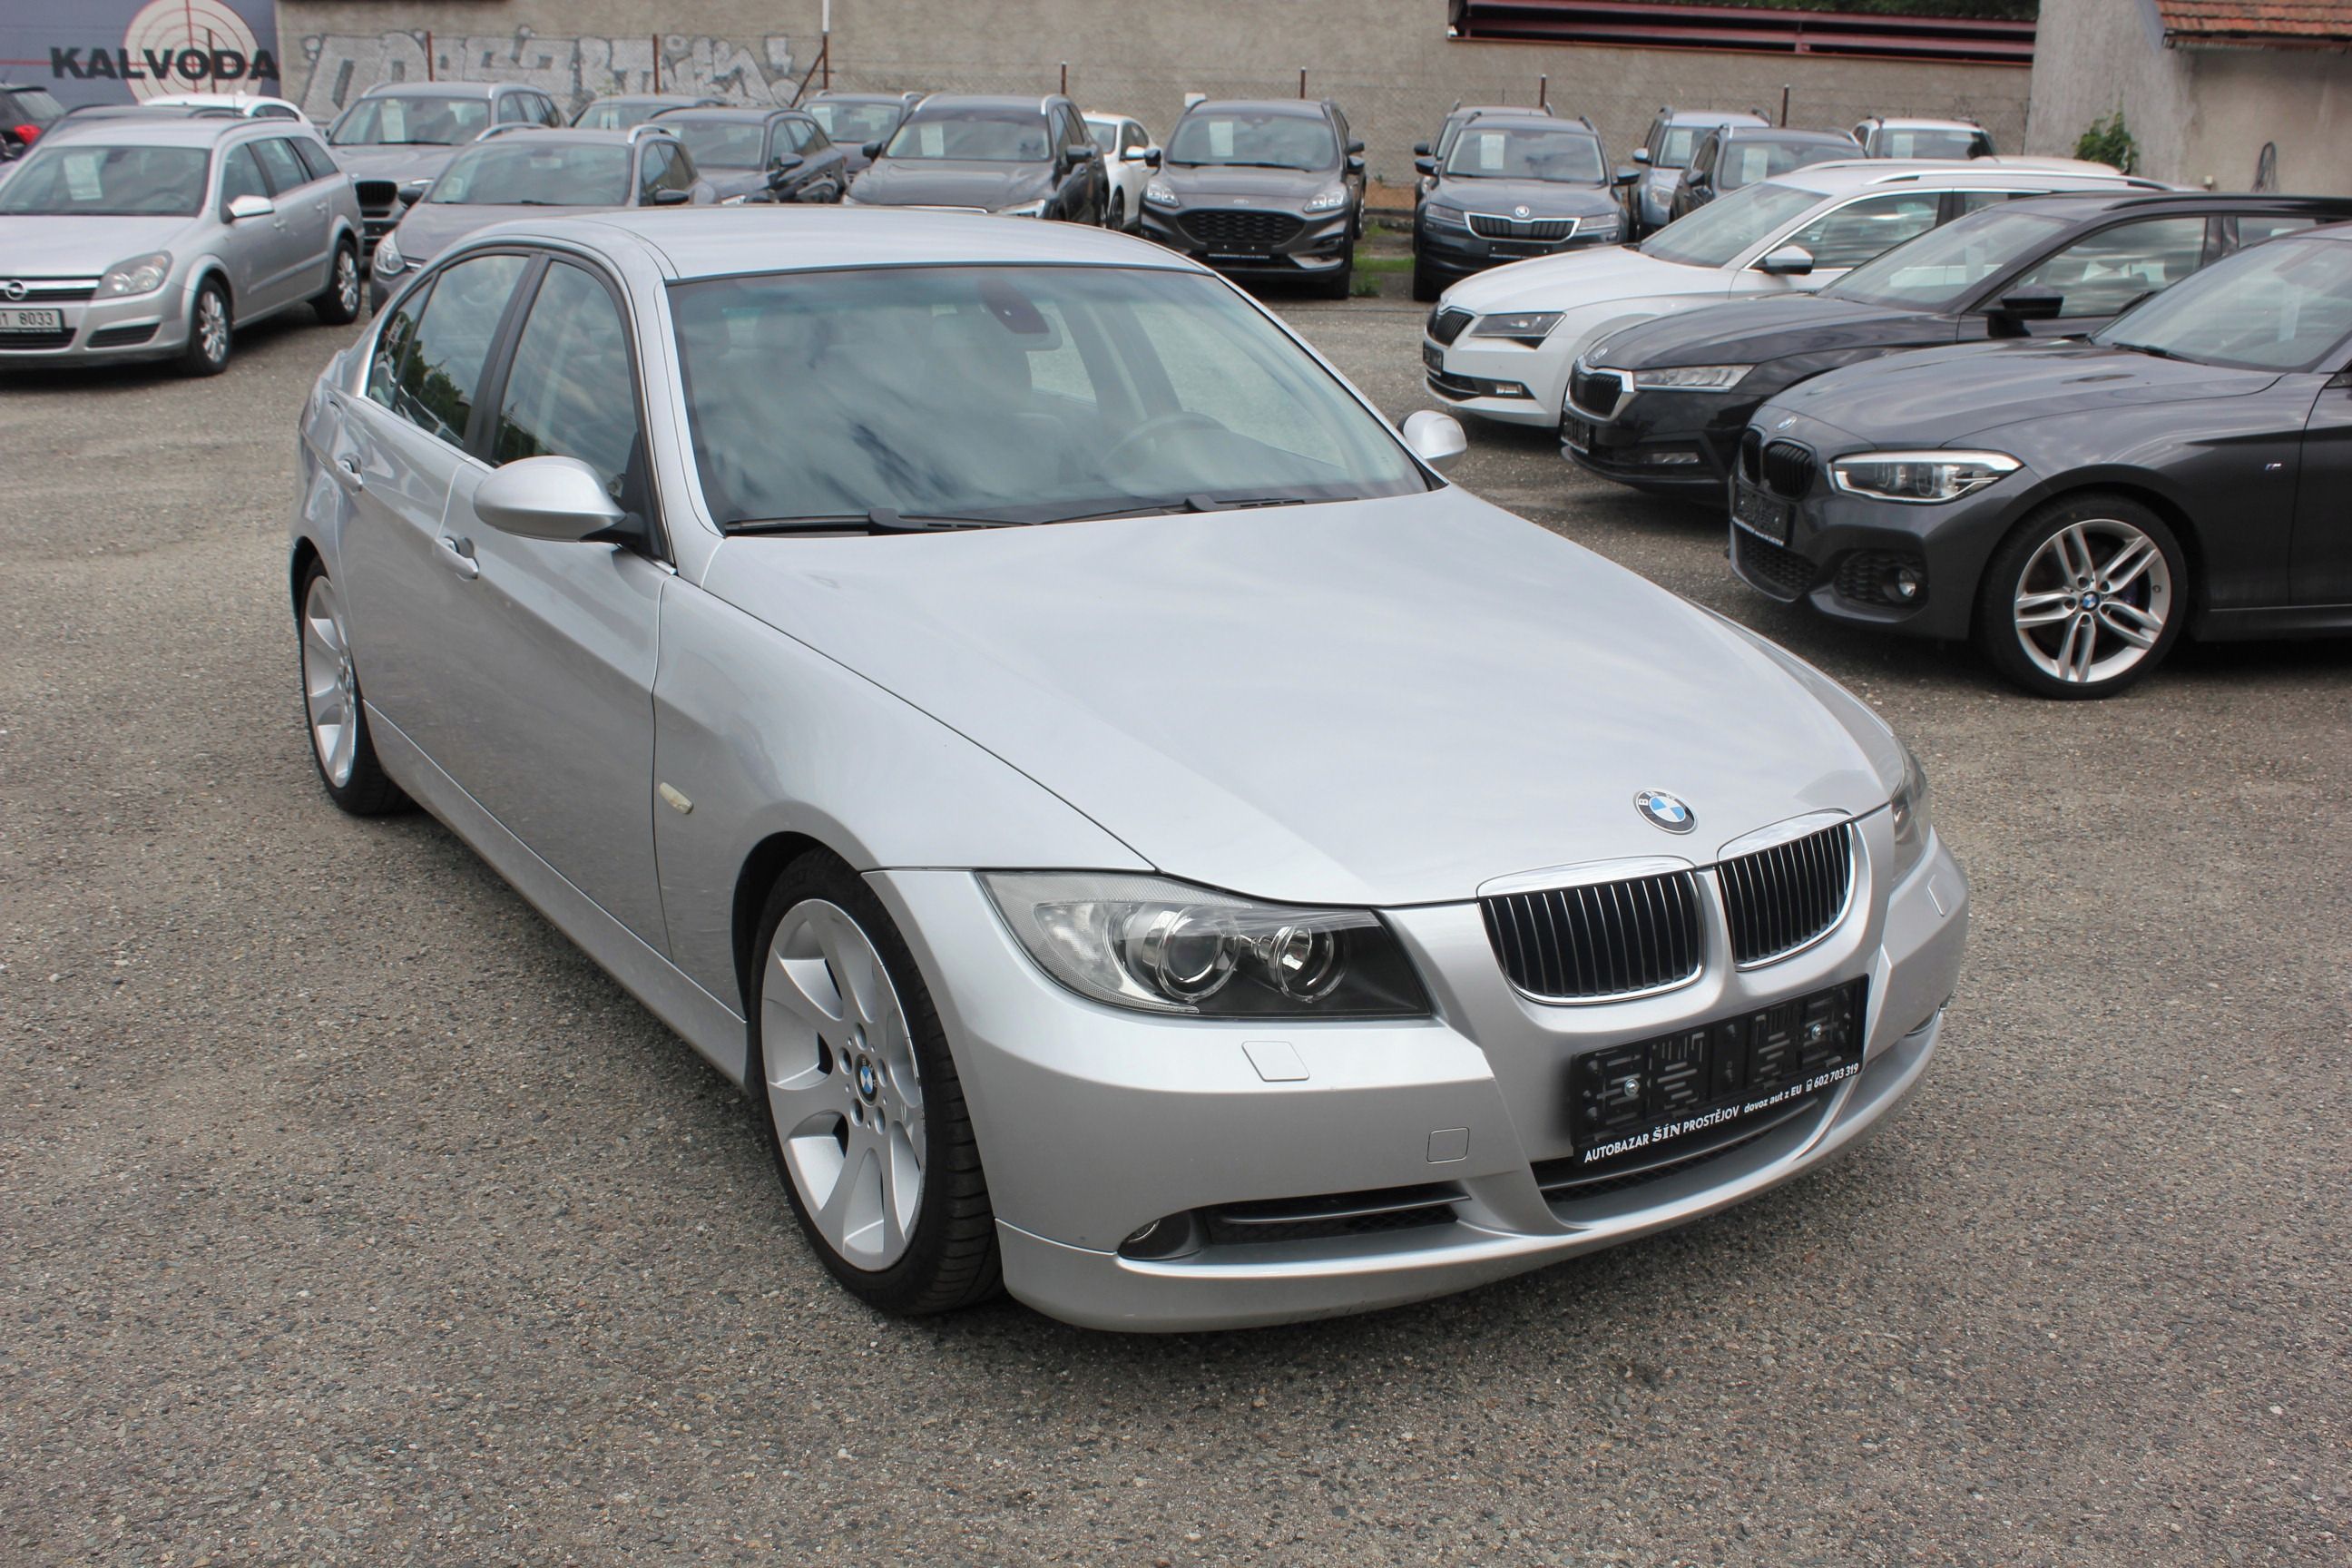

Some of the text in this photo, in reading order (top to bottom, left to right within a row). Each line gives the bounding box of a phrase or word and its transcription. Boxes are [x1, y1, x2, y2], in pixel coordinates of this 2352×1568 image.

[50, 46, 280, 81] KALVODA
[18, 311, 54, 326] 8033
[1583, 1062, 1859, 1163] AUTOBAZAR ŠÍN PROSTĚJOV dovoz aut z EU 602 703 319
